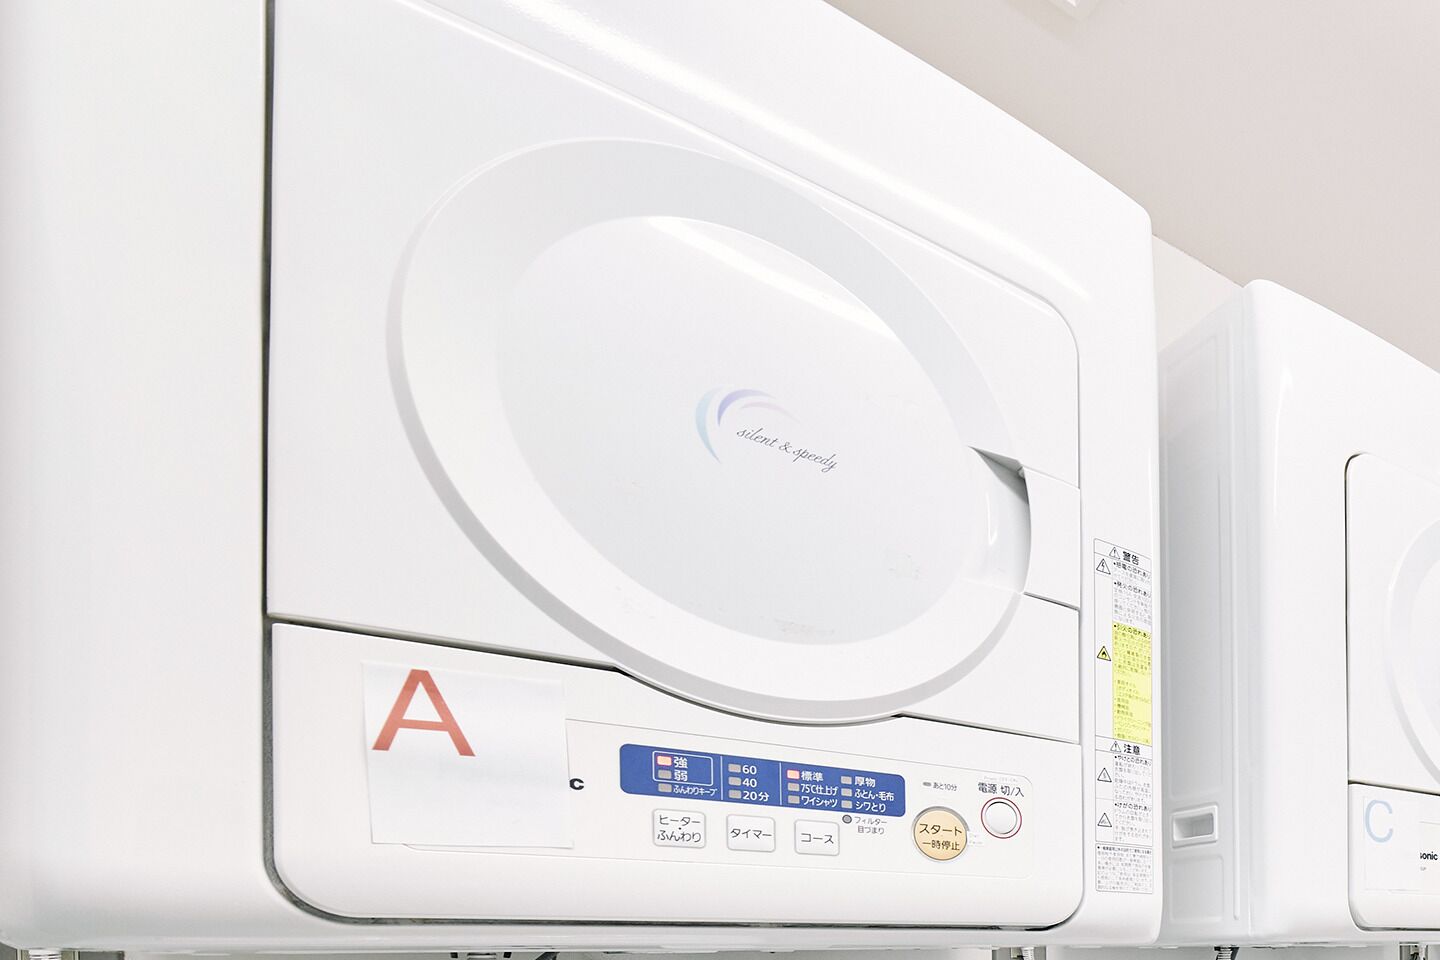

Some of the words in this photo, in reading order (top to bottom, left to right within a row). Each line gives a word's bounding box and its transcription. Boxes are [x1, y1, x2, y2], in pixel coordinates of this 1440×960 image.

[736, 427, 778, 448] silent
[778, 441, 794, 453] &
[792, 447, 838, 473] speedy
[372, 668, 476, 758] A
[673, 756, 688, 769] 強
[673, 769, 688, 782] 弱
[742, 765, 757, 775] 60
[801, 771, 824, 782] 標準
[854, 776, 876, 788] 厚物
[742, 778, 757, 788] 40
[978, 782, 998, 794] 電源
[673, 785, 717, 797] ふんわりキープ
[742, 791, 770, 802] 20分
[801, 796, 838, 808] ワイシャツ
[855, 801, 886, 813] シワとり
[659, 814, 701, 827] ヒーター
[1364, 799, 1394, 844] C
[657, 829, 702, 843] ふんわり
[730, 828, 772, 840] タイマー
[919, 823, 963, 837] スタート
[801, 832, 835, 845] コース
[922, 839, 960, 851] 一時停止
